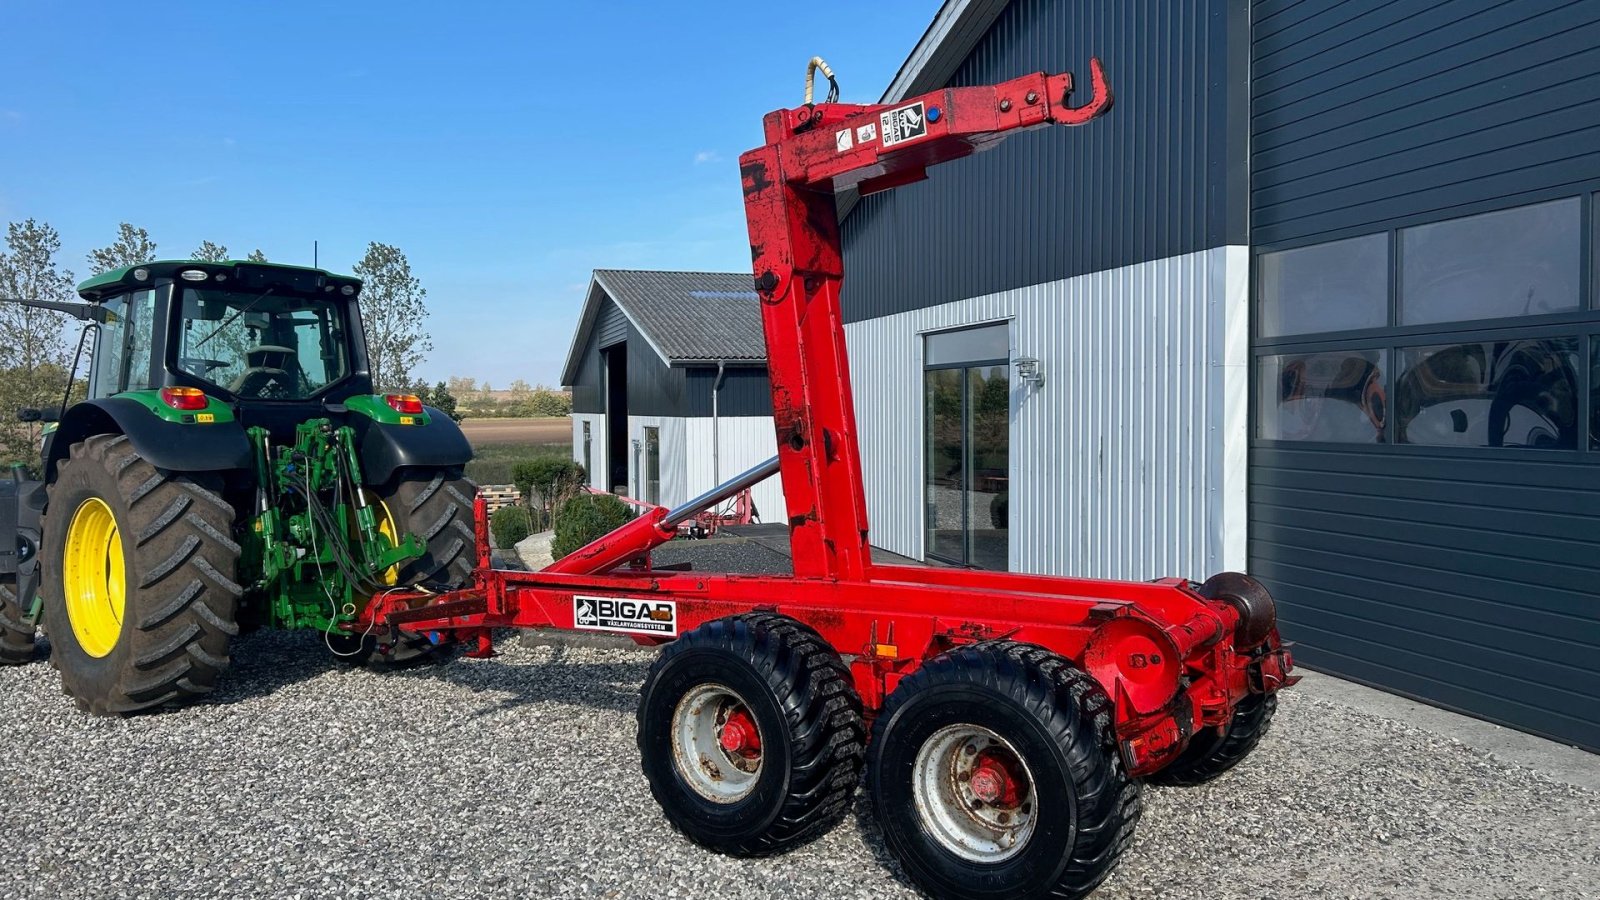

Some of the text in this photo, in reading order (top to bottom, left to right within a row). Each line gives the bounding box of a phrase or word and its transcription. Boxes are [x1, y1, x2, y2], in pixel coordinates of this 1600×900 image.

[882, 116, 889, 126] 12
[892, 111, 900, 142] BIGAB
[884, 132, 891, 143] 15
